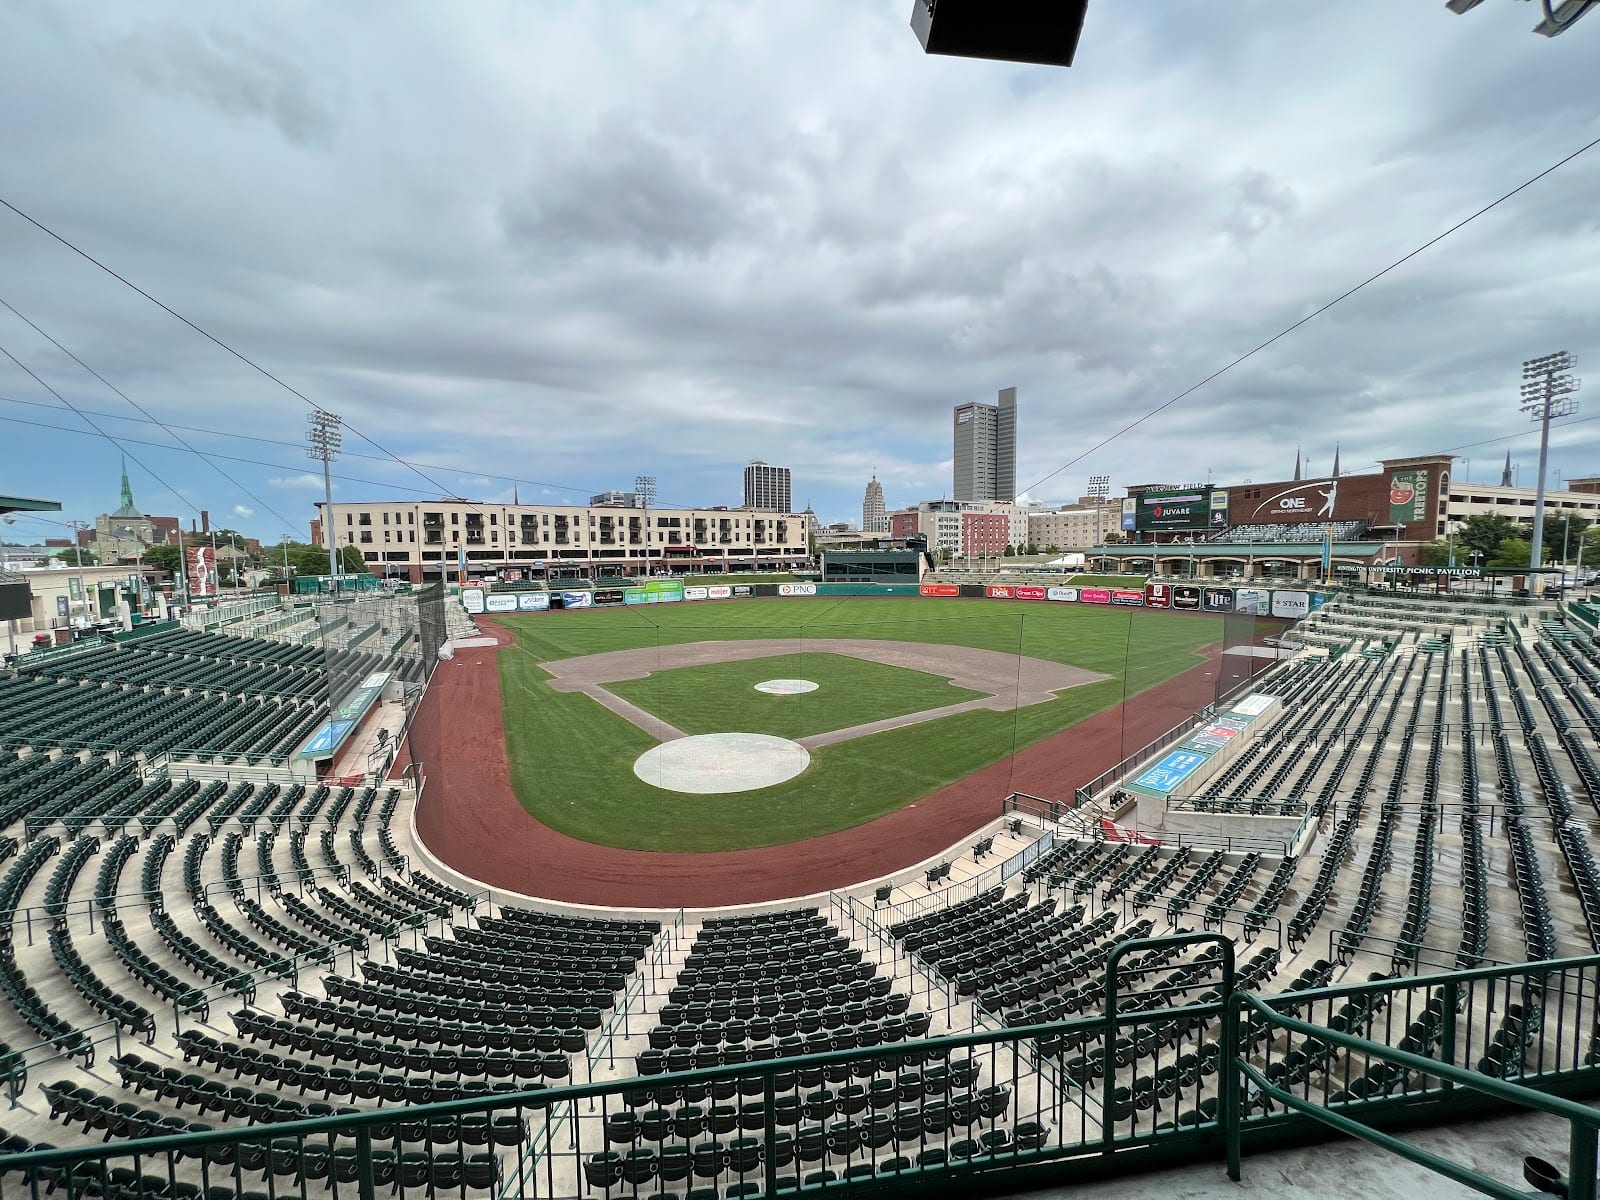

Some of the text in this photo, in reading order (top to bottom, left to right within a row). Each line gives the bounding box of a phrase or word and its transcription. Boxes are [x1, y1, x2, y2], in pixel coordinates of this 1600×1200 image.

[1414, 470, 1427, 520] TREETOPS
[1280, 497, 1305, 508] ONE
[1163, 508, 1190, 516] JUVARE
[1369, 566, 1404, 574] UNIVERSITY
[1437, 568, 1480, 576] PAVILION
[793, 585, 814, 593] PNC
[1208, 593, 1231, 607] Lite
[1282, 600, 1305, 608] STAR
